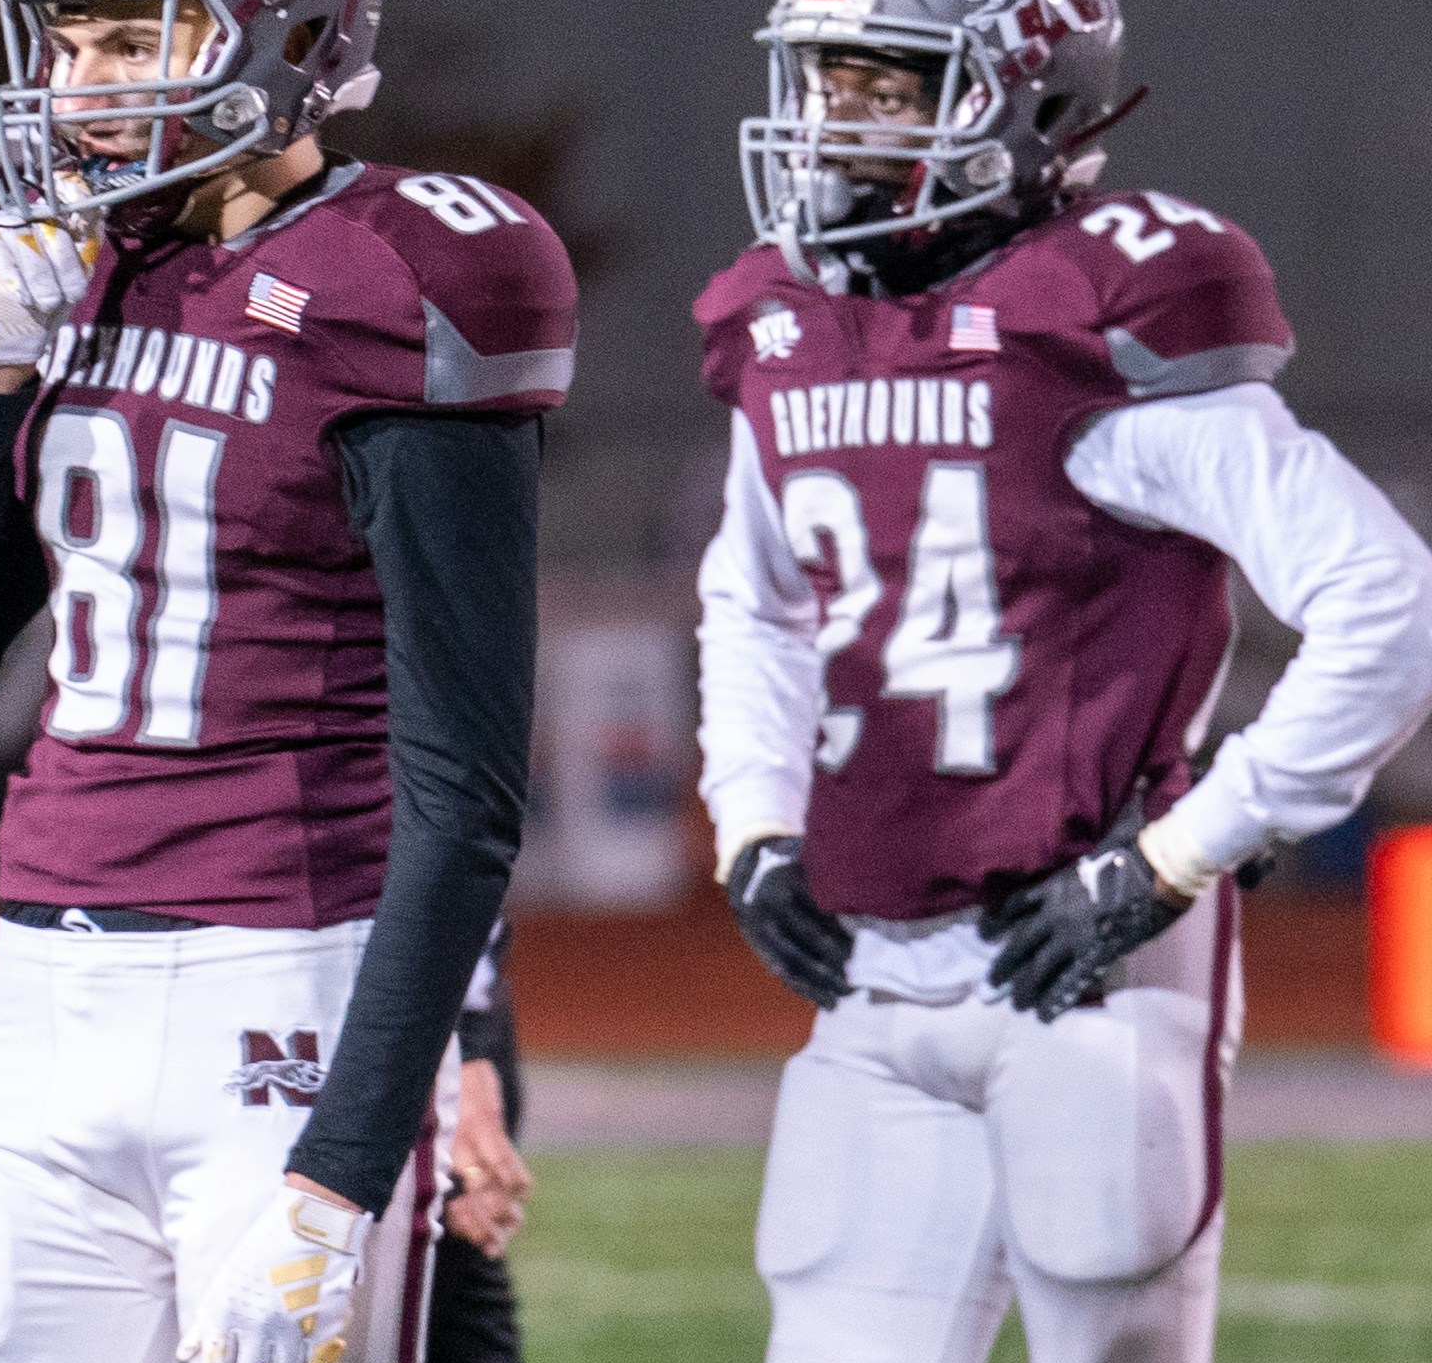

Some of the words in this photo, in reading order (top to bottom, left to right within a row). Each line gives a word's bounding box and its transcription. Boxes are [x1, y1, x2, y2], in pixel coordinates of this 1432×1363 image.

[394, 174, 528, 234] 81
[1080, 190, 1225, 264] 24
[770, 377, 994, 460] GREYHOUNDS
[35, 405, 228, 747] 81
[781, 461, 1023, 775] 24
[239, 1029, 321, 1108] N
